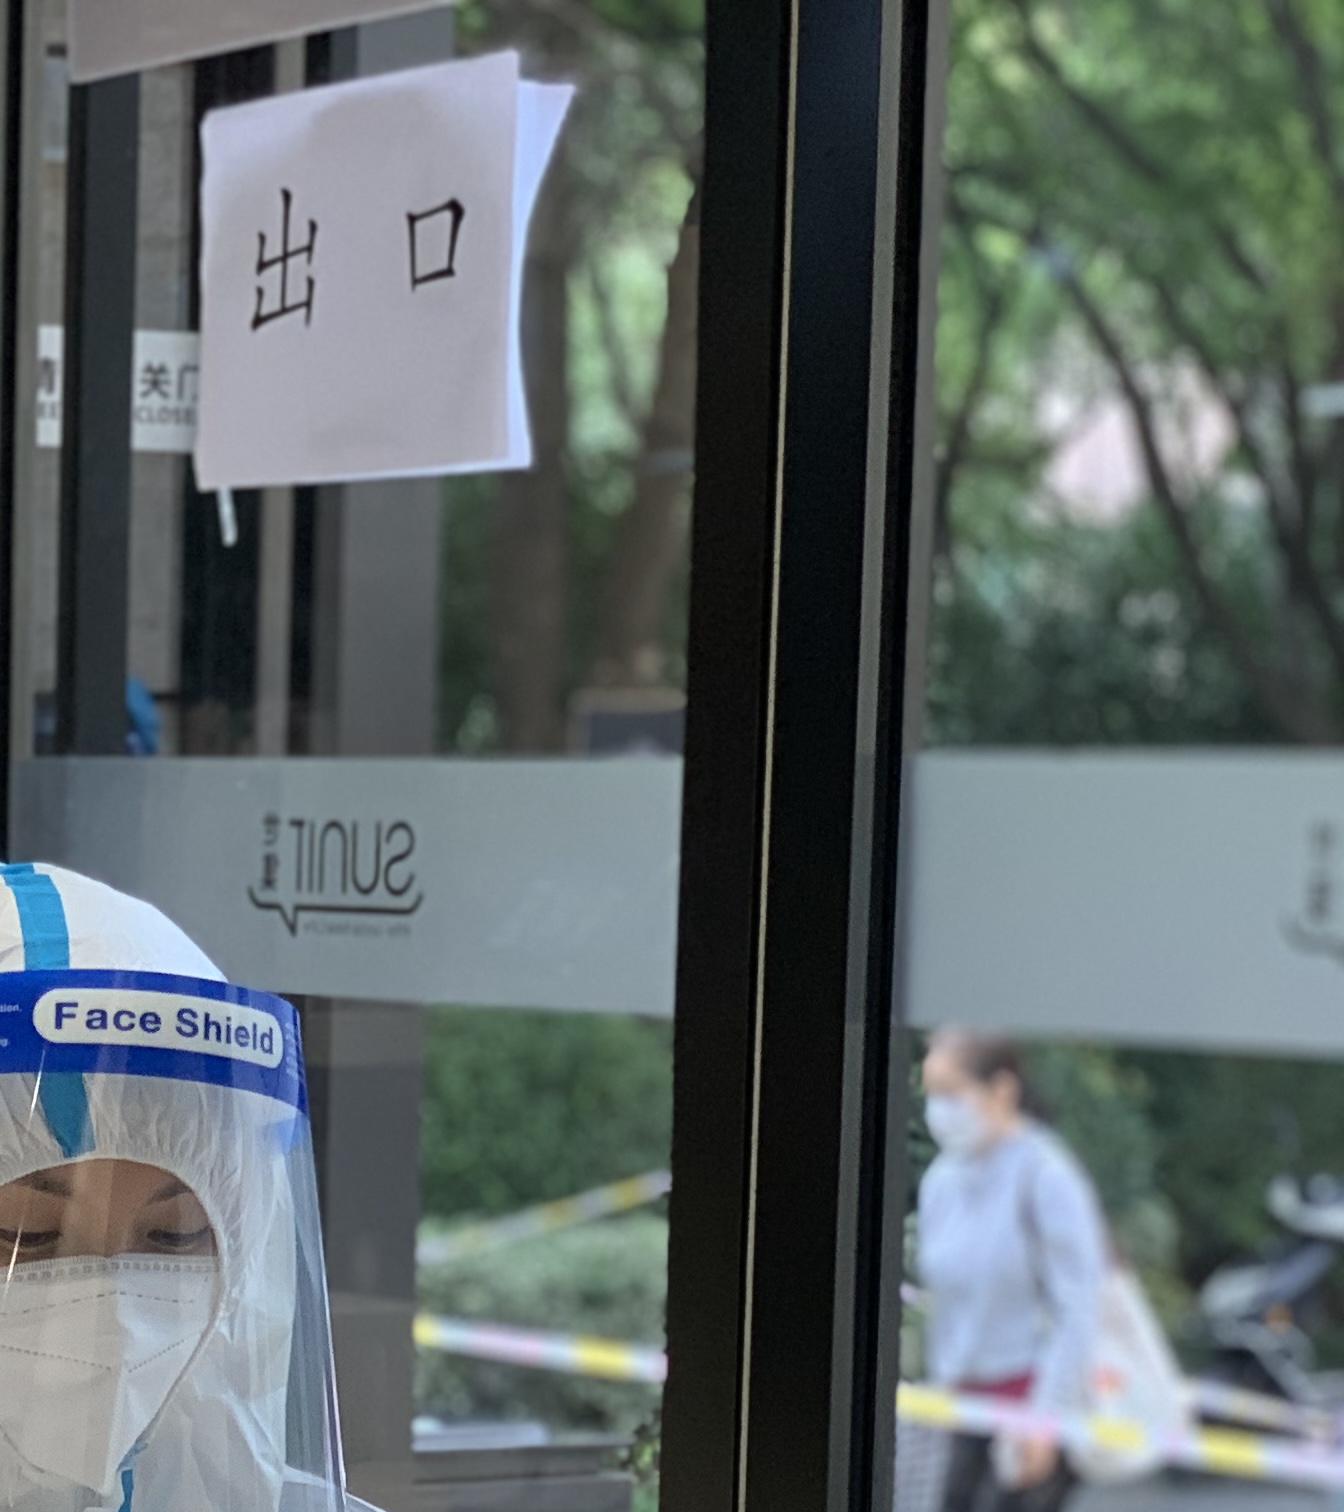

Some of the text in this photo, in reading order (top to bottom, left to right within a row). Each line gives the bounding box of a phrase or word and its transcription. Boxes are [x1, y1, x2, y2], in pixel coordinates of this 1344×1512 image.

[250, 186, 465, 333] 出口
[54, 1001, 162, 1034] Face
[175, 1008, 274, 1056] Shield
